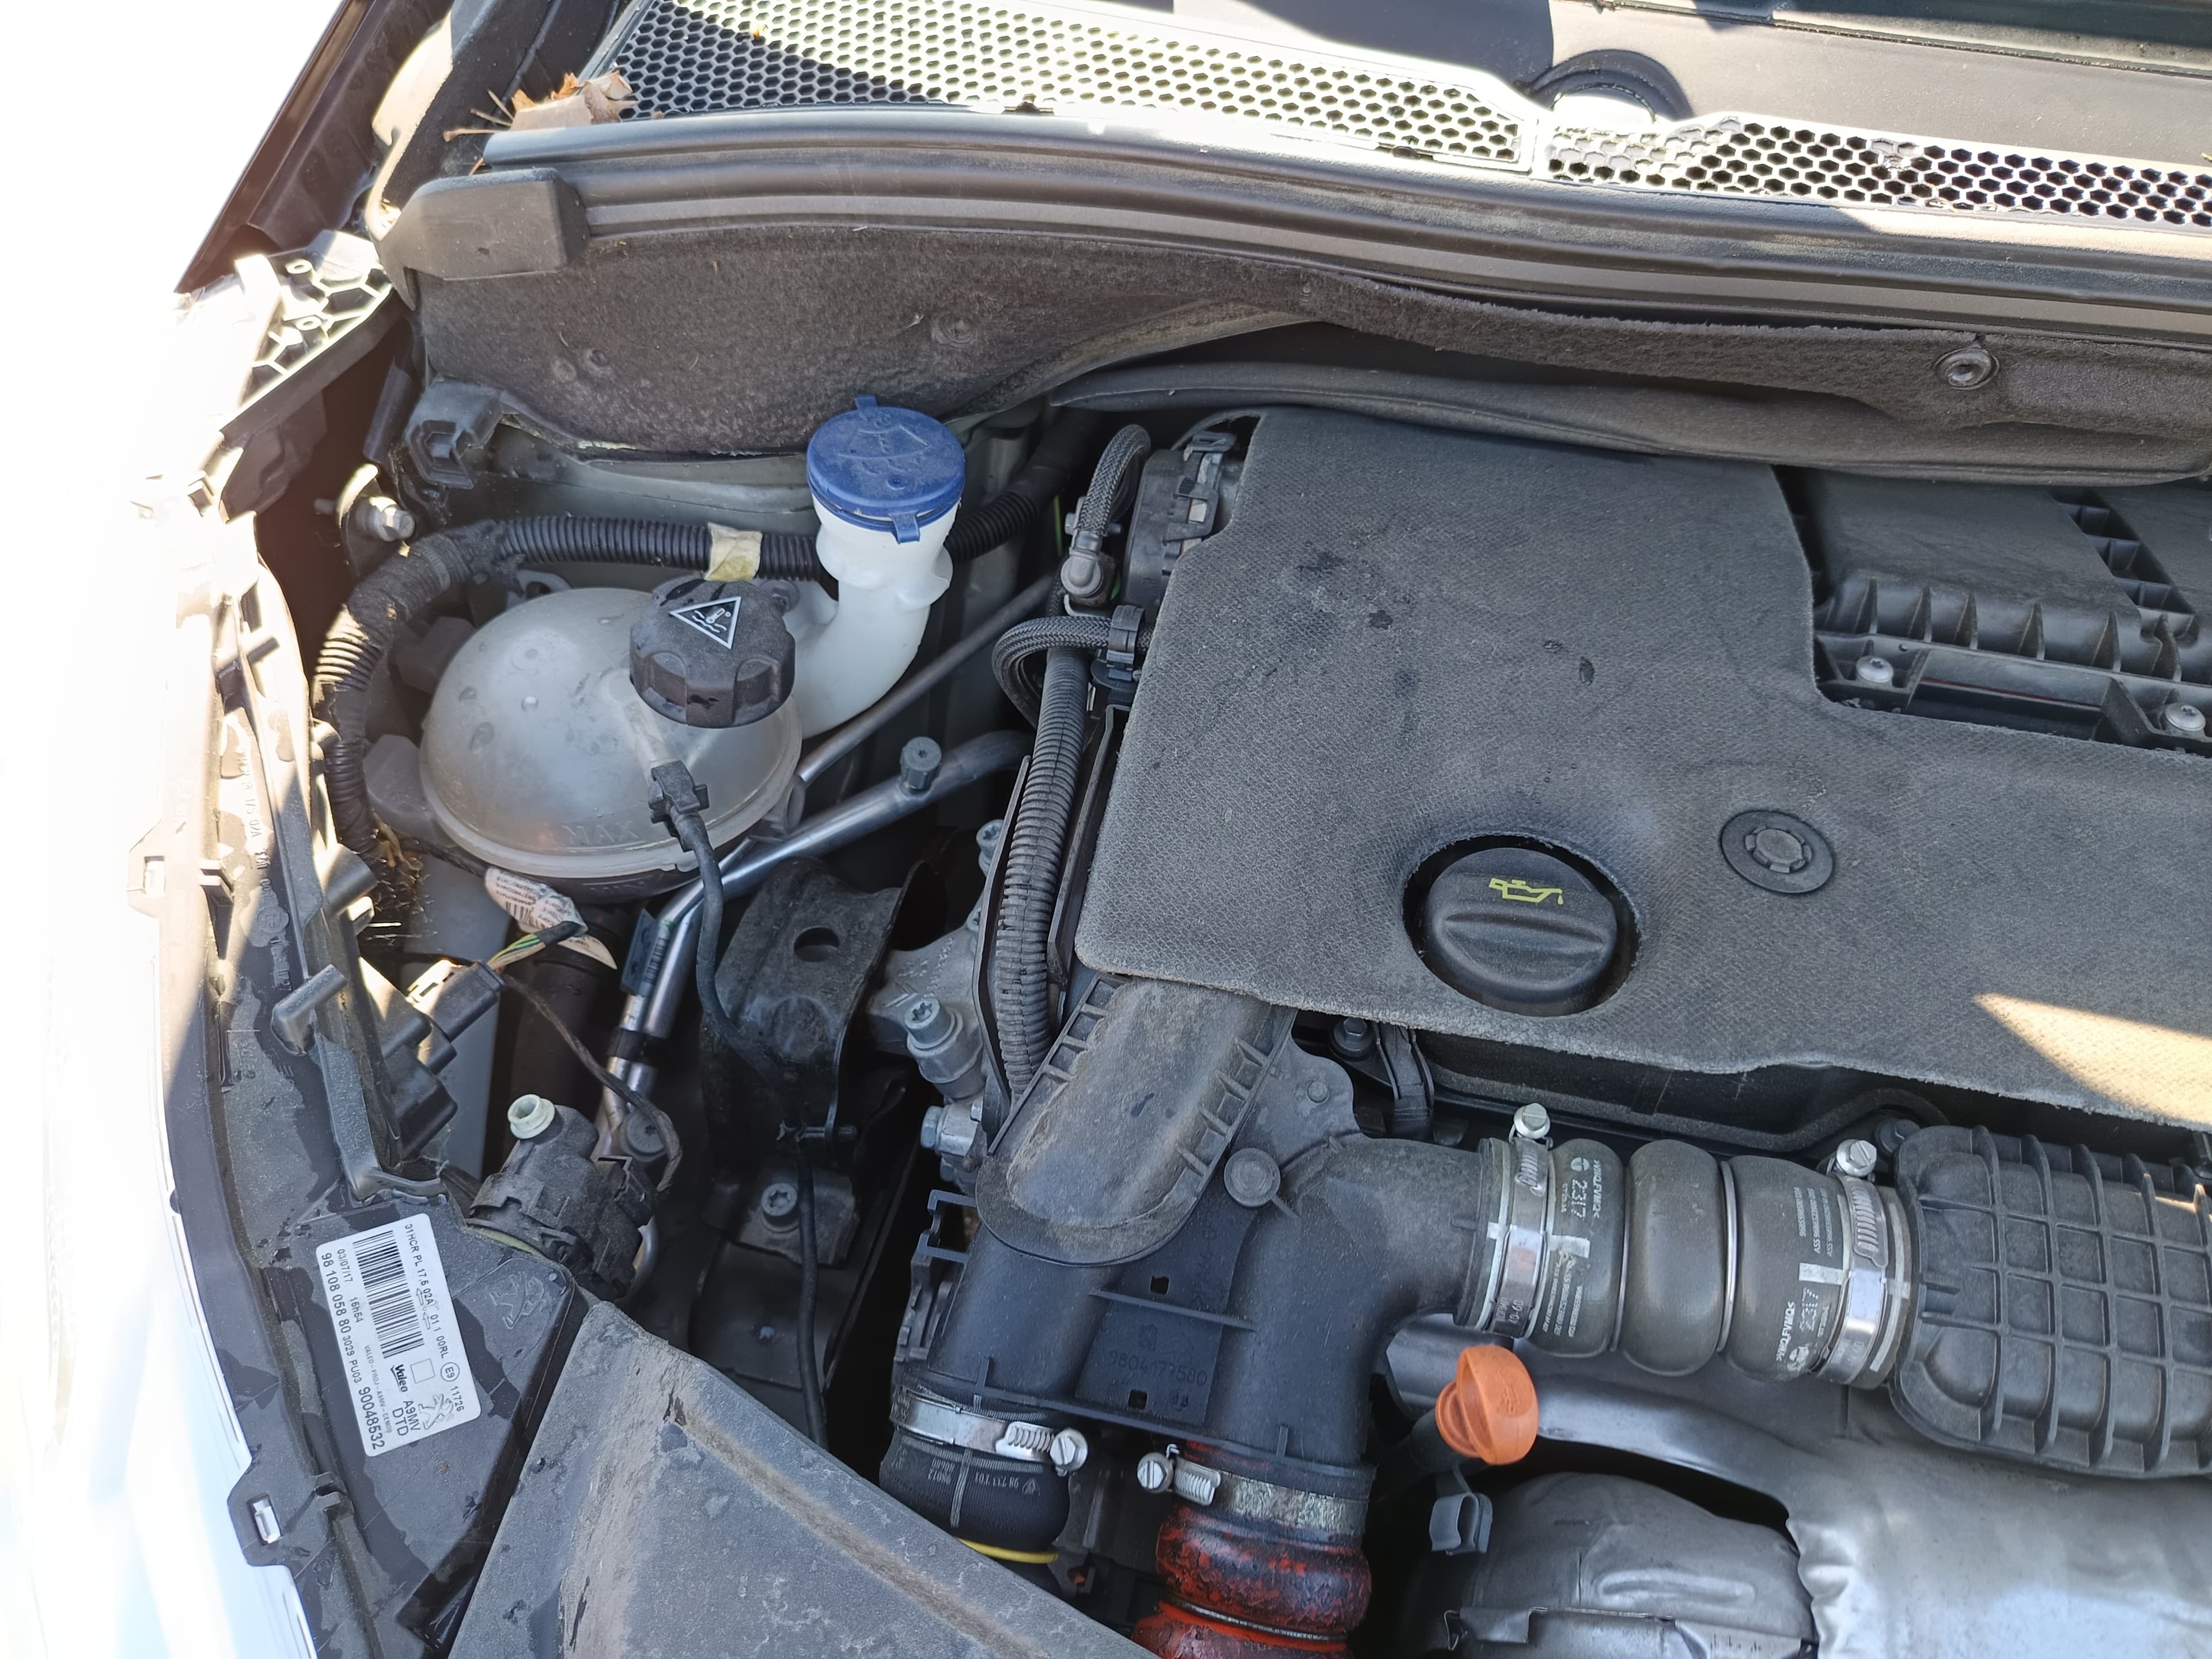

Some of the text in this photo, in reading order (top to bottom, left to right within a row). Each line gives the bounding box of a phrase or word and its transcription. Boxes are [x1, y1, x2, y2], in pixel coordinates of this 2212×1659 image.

[1813, 1238, 1821, 1253] ASS
[336, 1248, 354, 1283] 03/07/17
[412, 1253, 424, 1267] PL
[421, 1287, 434, 1305] 02A
[429, 1313, 440, 1325] 01
[320, 1251, 386, 1450] 98 108 058 80 3029 PU03 90048532
[435, 1335, 449, 1359] 00RL
[444, 1365, 456, 1379] E9
[393, 1363, 421, 1432] Valeo A9MV
[449, 1384, 465, 1412] 11726
[391, 1407, 410, 1437] DTD
